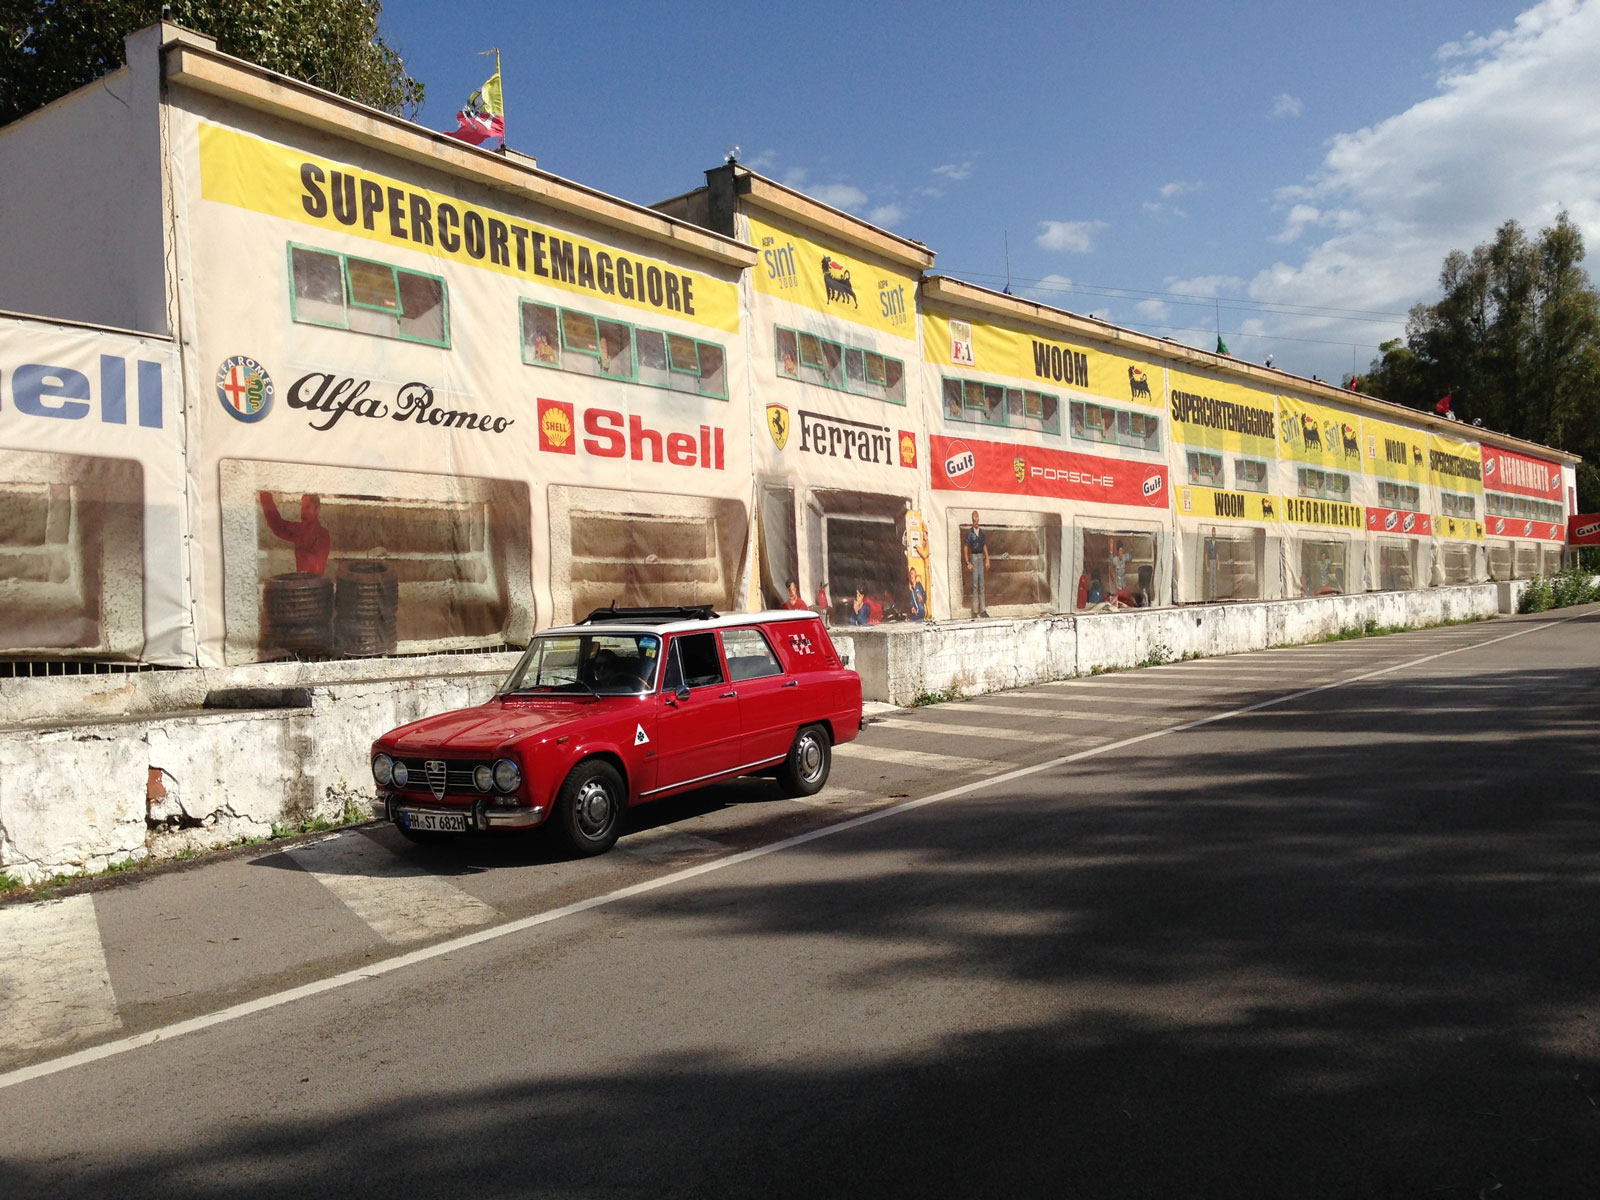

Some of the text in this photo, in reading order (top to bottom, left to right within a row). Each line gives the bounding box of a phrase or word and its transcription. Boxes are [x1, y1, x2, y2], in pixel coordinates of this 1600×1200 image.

[300, 162, 696, 316] SUPERCORTEMAGGIORE
[217, 356, 273, 395] ALFA ROMEO
[1032, 340, 1089, 388] WOOM
[0, 354, 163, 429] ell
[286, 372, 515, 434] Alfa Romeo
[545, 421, 568, 433] SHELL
[1171, 389, 1275, 439] SUPERCORTEMAGGIORE
[583, 407, 725, 470] Shell
[798, 409, 893, 465] Ferrari
[947, 454, 973, 475] Gulf
[1031, 466, 1114, 487] PORSCHE
[1143, 476, 1162, 494] Gulf
[1214, 492, 1245, 518] WOOM
[1287, 498, 1361, 528] RIFORNIMENTO
[425, 815, 437, 829] ST
[440, 817, 465, 830] 682H
